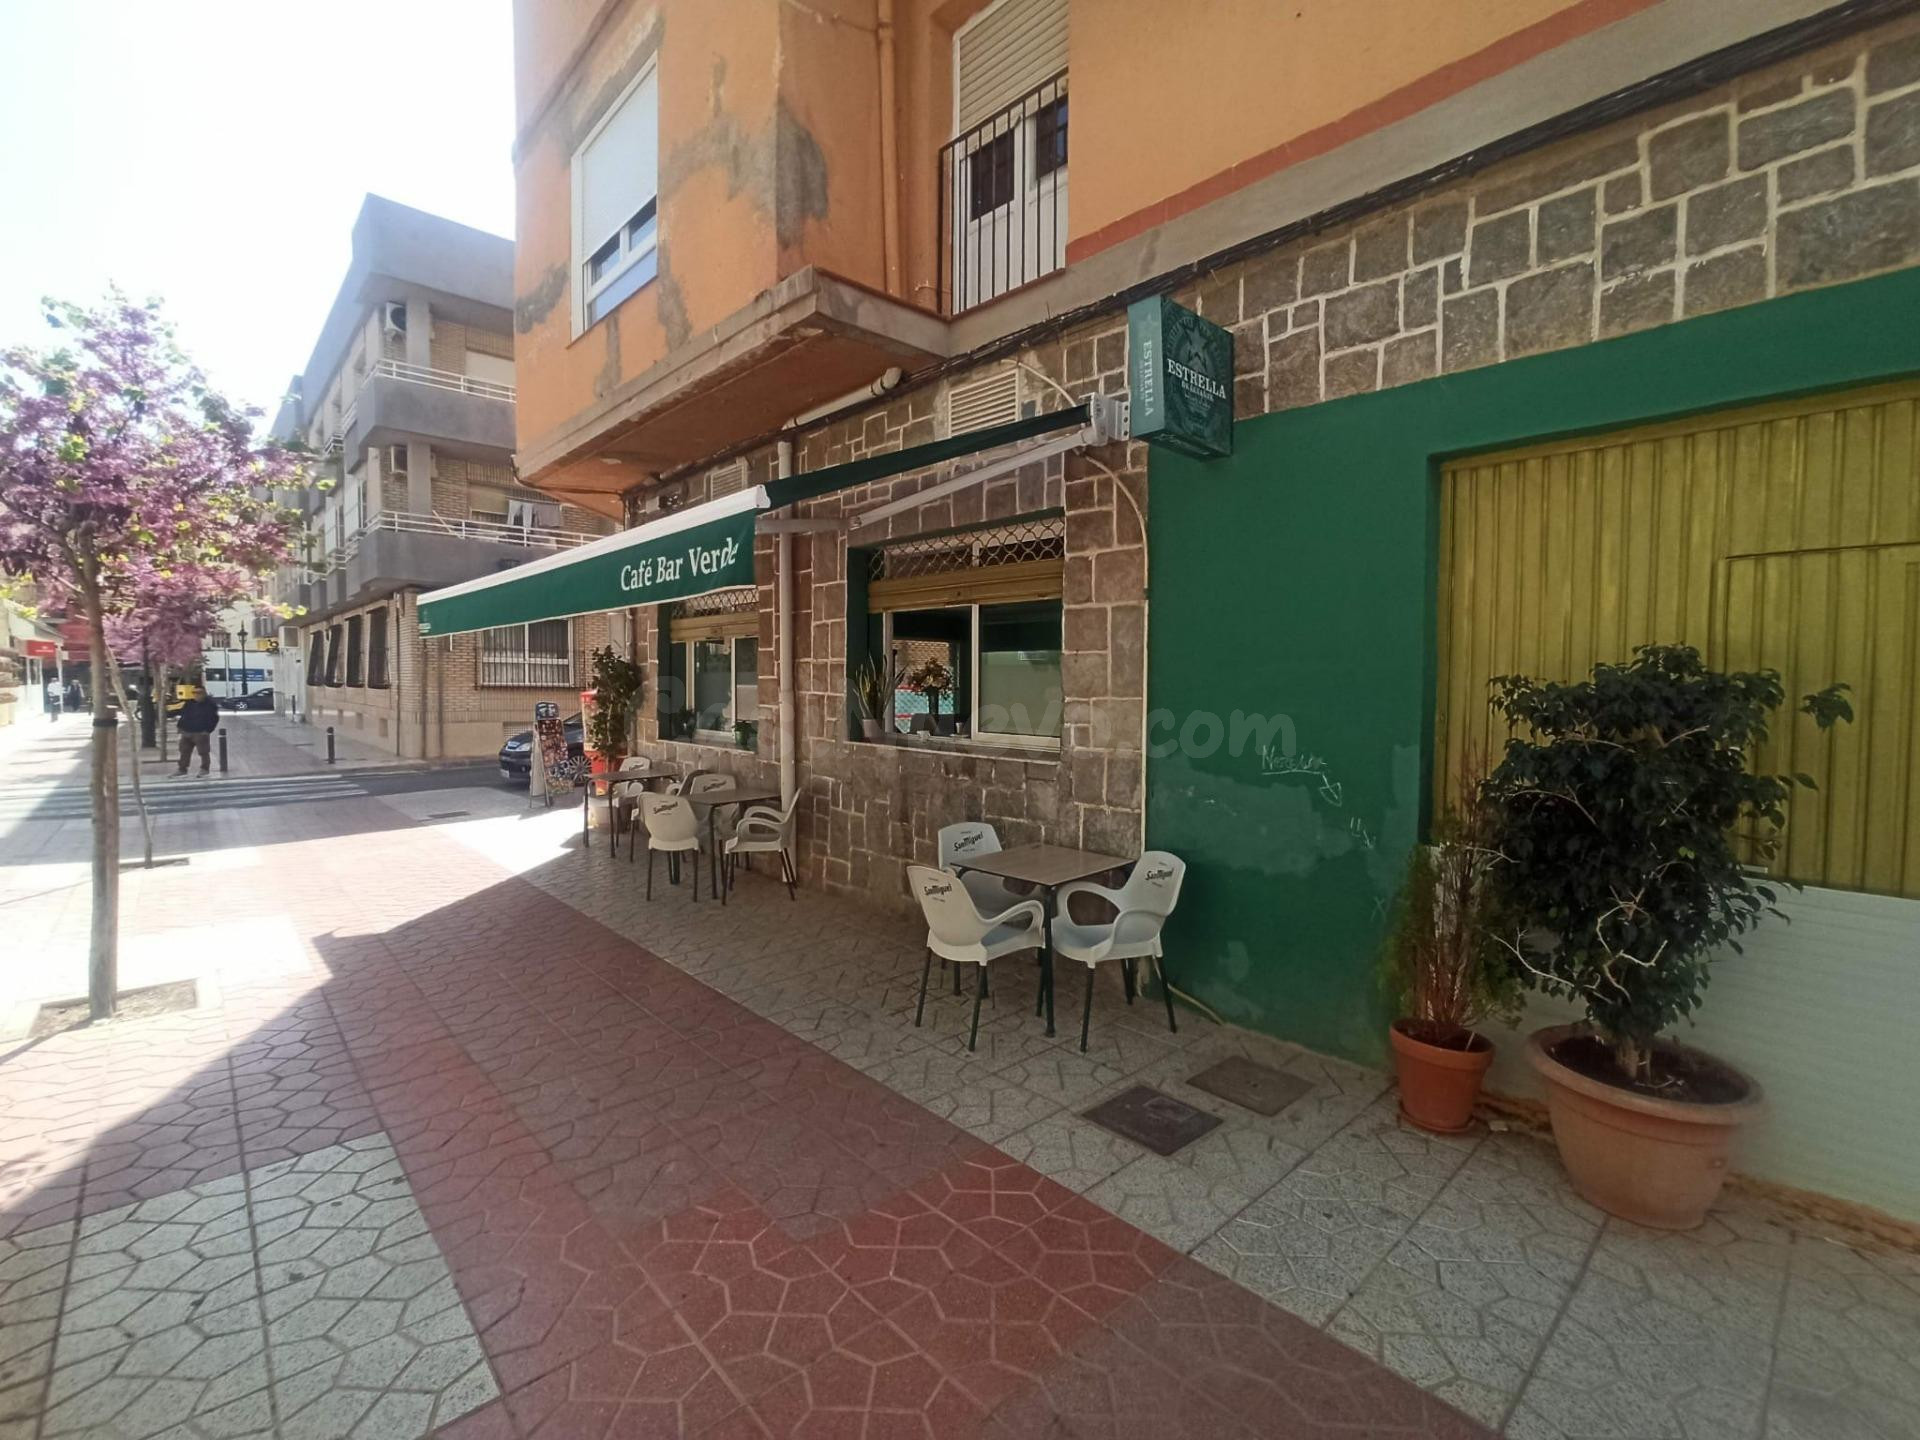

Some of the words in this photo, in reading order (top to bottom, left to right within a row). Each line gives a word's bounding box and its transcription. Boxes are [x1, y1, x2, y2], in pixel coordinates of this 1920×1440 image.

[1143, 340, 1154, 416] ESTRELLA
[1167, 358, 1226, 399] ESTRELLA
[621, 558, 652, 591] Café
[656, 556, 683, 583] Bar
[689, 537, 739, 577] Verde
